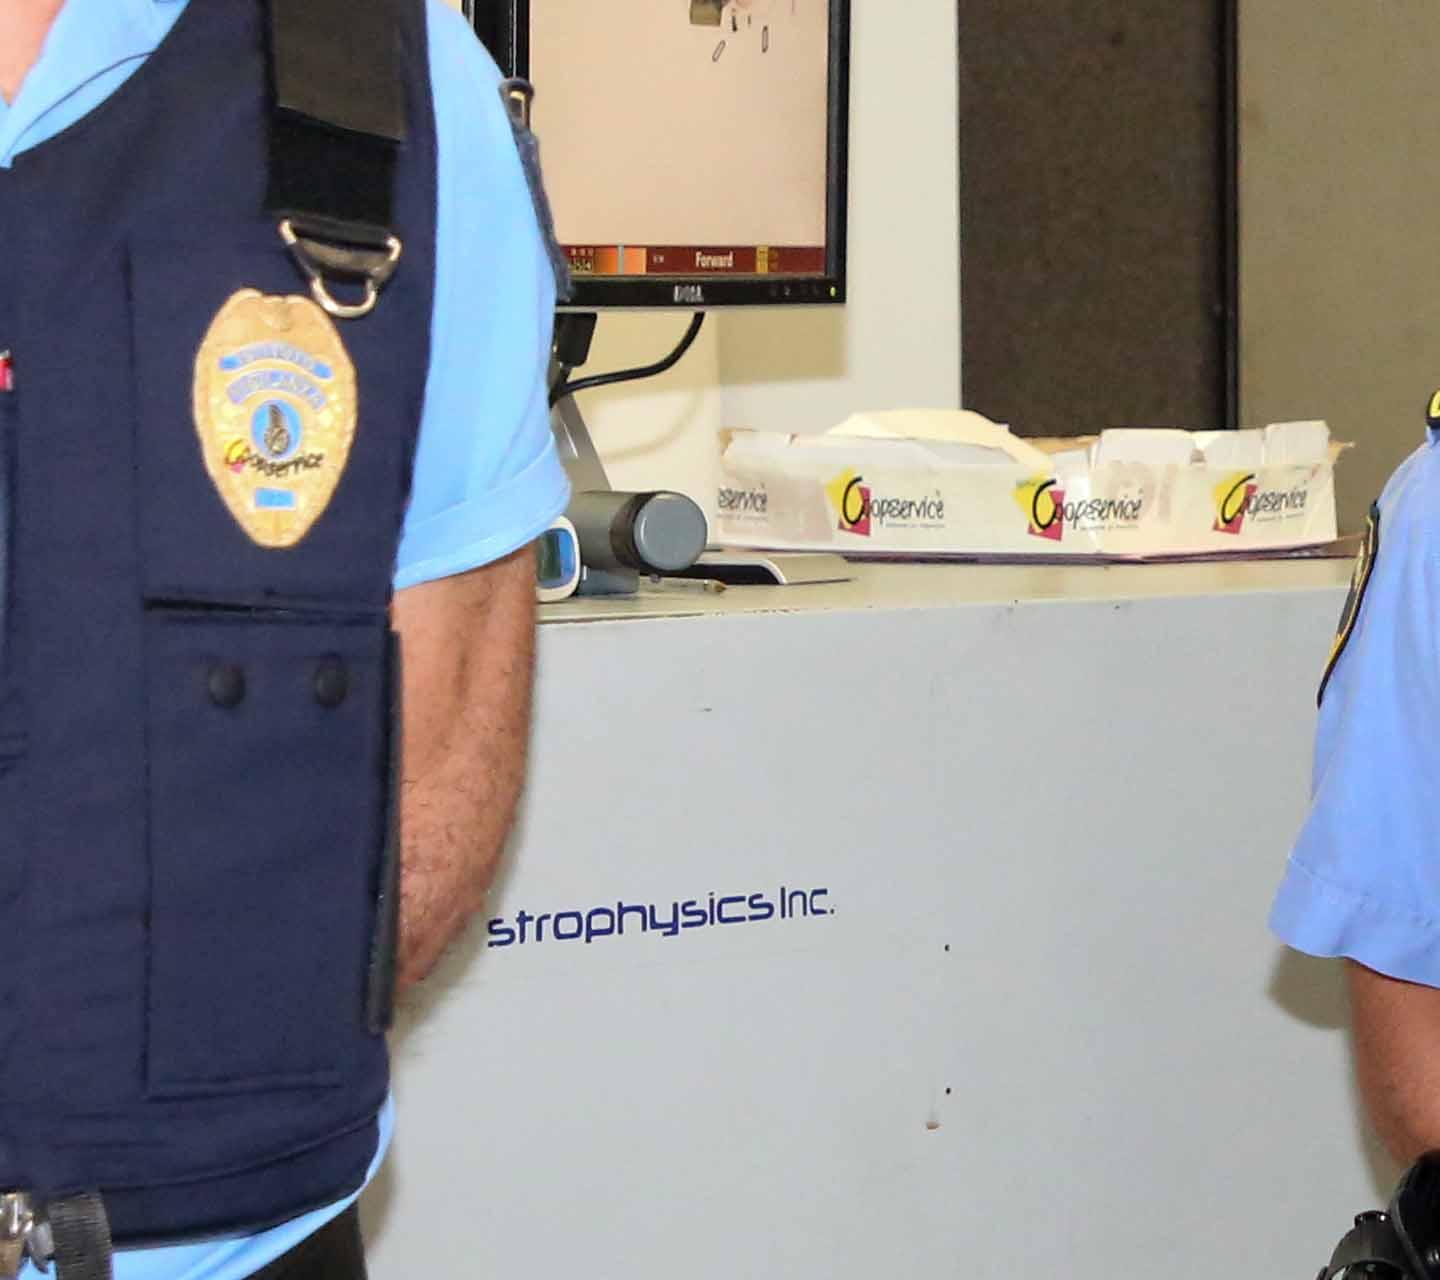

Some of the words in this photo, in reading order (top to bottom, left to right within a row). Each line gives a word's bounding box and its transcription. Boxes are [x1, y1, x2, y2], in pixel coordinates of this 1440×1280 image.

[695, 251, 734, 269] Forward
[487, 892, 775, 948] strophysics
[779, 886, 835, 919] Inc.
